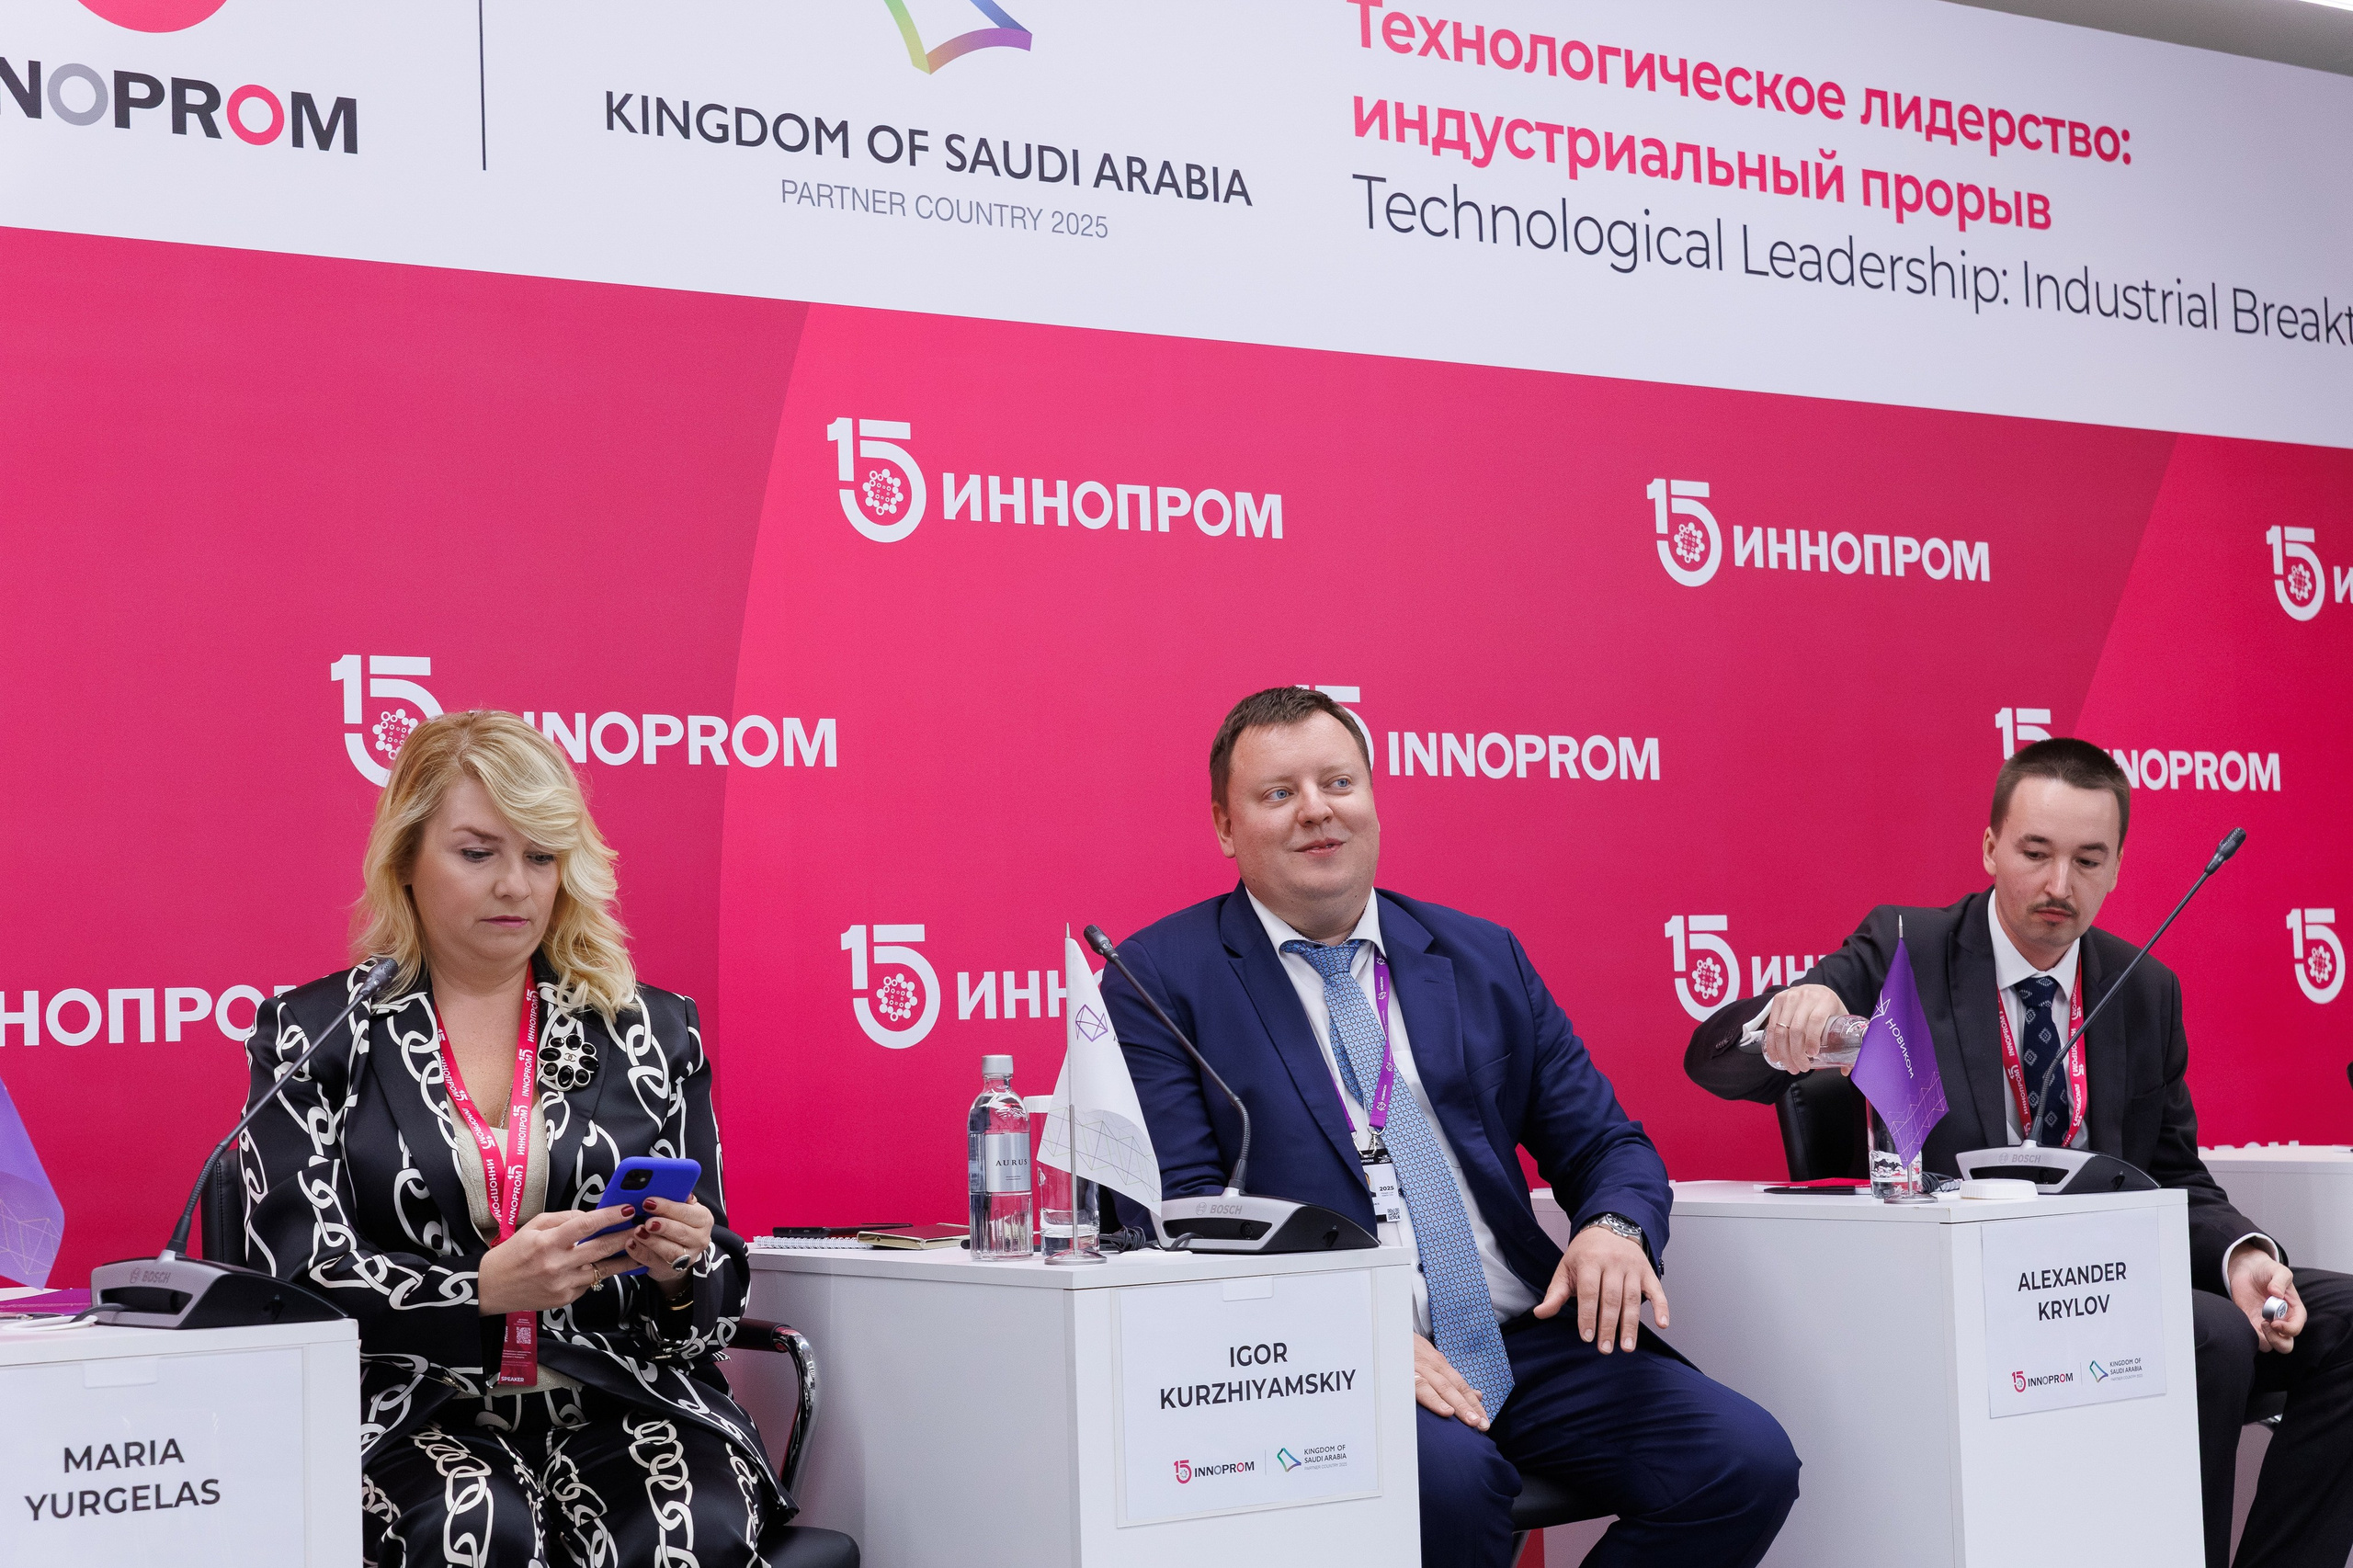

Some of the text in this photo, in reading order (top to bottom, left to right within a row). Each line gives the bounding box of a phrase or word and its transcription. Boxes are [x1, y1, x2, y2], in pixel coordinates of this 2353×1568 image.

[1347, 0, 2131, 165] Технологическое лидерство:
[606, 90, 1253, 207] KINGDOM OF SAUDI ARABIA
[1353, 95, 2052, 232] индустриальный прорыв
[780, 178, 1108, 240] PARTNER COUNTRY 2025
[1352, 173, 1723, 274] Technological
[1742, 223, 2010, 314] Leadership:
[2023, 260, 2218, 331] Industrial
[826, 416, 1284, 543] 15 ИННОПРОМ
[1646, 478, 1991, 587] 15 ИННОПРОМ
[2266, 525, 2325, 621] 15
[523, 710, 838, 768] NOPROM
[1387, 731, 1661, 781] INNOPROM
[2105, 748, 2281, 792] NOPROM
[2286, 908, 2346, 1005] 15
[840, 924, 941, 1050] 15
[0, 984, 297, 1047] НОПРО
[1885, 1017, 1915, 1079] НОВИКОМ
[521, 1054, 532, 1097] INNOPROM
[517, 1112, 529, 1155] ИННОПРОМ
[2012, 1154, 2041, 1163] BOSCH
[485, 1159, 502, 1218] ИННОПРОМ
[508, 1172, 523, 1225] INNOPROM
[1210, 1204, 1243, 1214] BOSCH
[2018, 1261, 2127, 1292] ALEXANDER
[2038, 1293, 2110, 1321] KRYLOV
[1230, 1342, 1288, 1368] IGOR
[1160, 1369, 1357, 1410] KURZHIYAMSKIY
[2012, 1370, 2074, 1393] 15 INNOPROM
[63, 1437, 185, 1473] MARIA
[1174, 1460, 1255, 1484] 15 INNOPROM
[1304, 1446, 1336, 1455] KINGDOM
[1304, 1453, 1347, 1463] SAUDI ARABIA
[24, 1478, 221, 1521] YURGELAS
